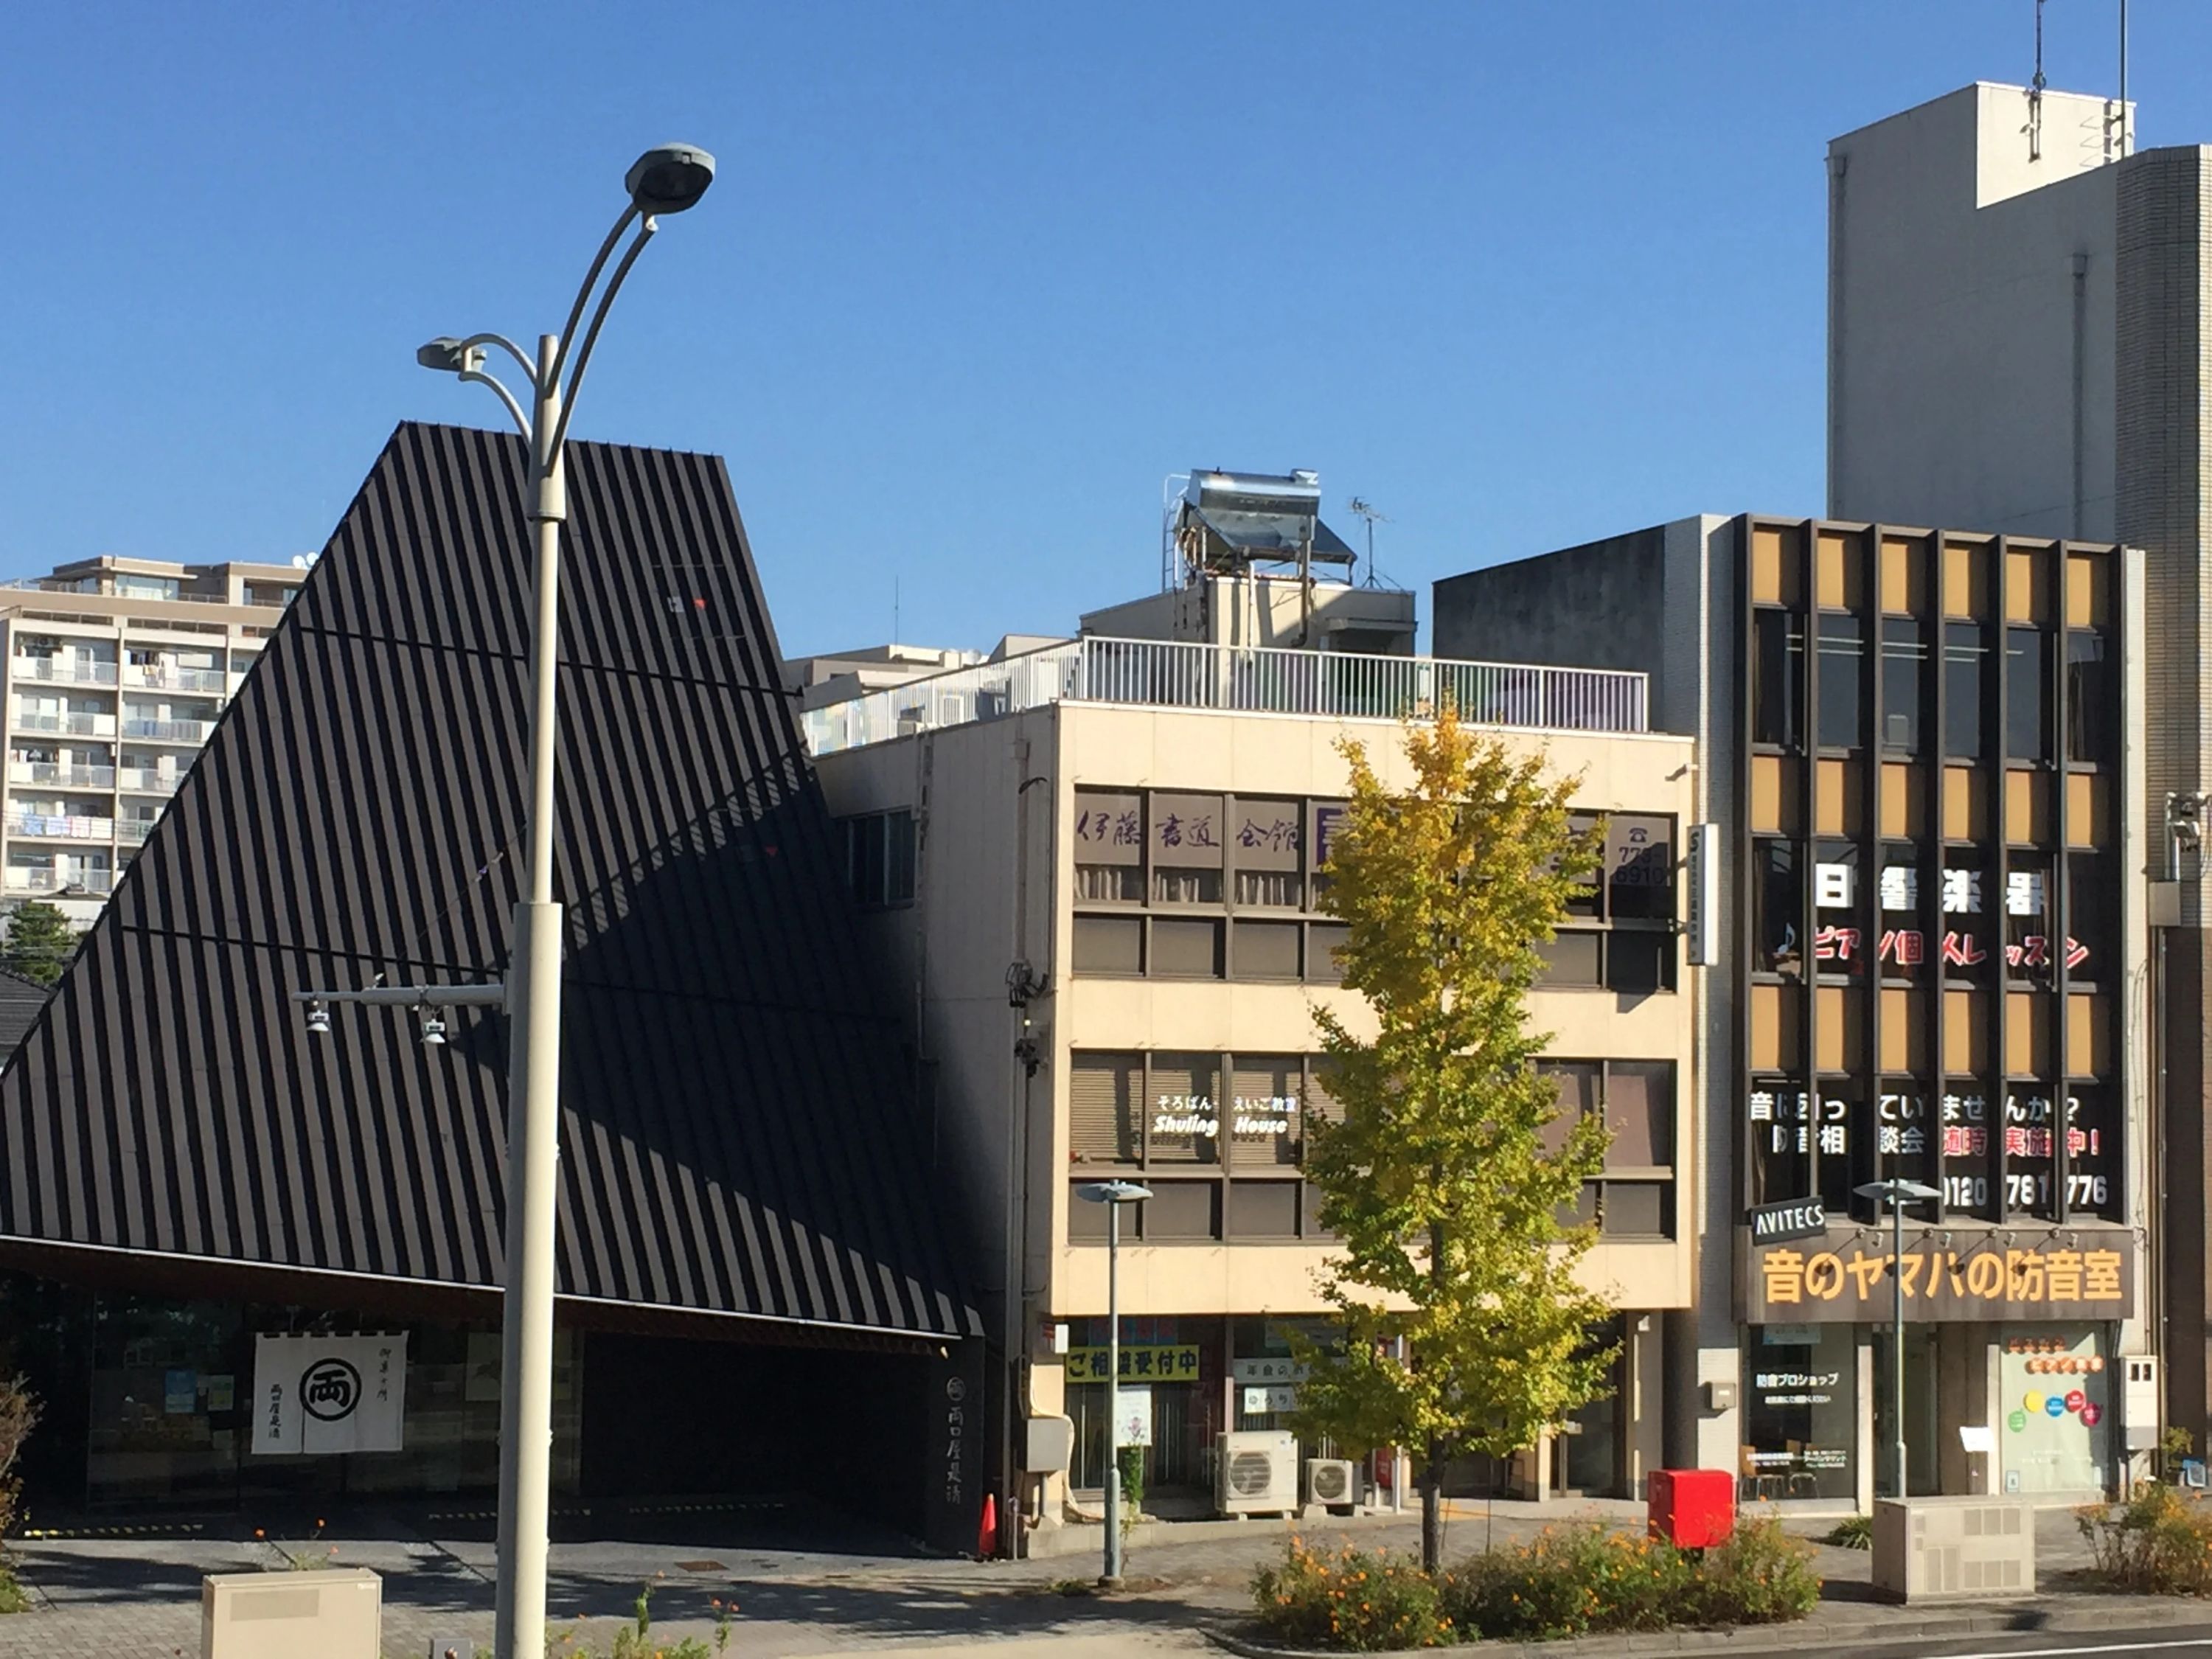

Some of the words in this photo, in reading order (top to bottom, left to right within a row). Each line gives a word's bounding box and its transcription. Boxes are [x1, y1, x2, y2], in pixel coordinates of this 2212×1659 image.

[1153, 1114, 1219, 1138] Shuling
[1234, 1116, 1288, 1134] House
[1756, 1204, 1824, 1237] AVITECS
[1763, 1249, 2121, 1304] 音のヤマハの防音室
[310, 1368, 351, 1408] 両
